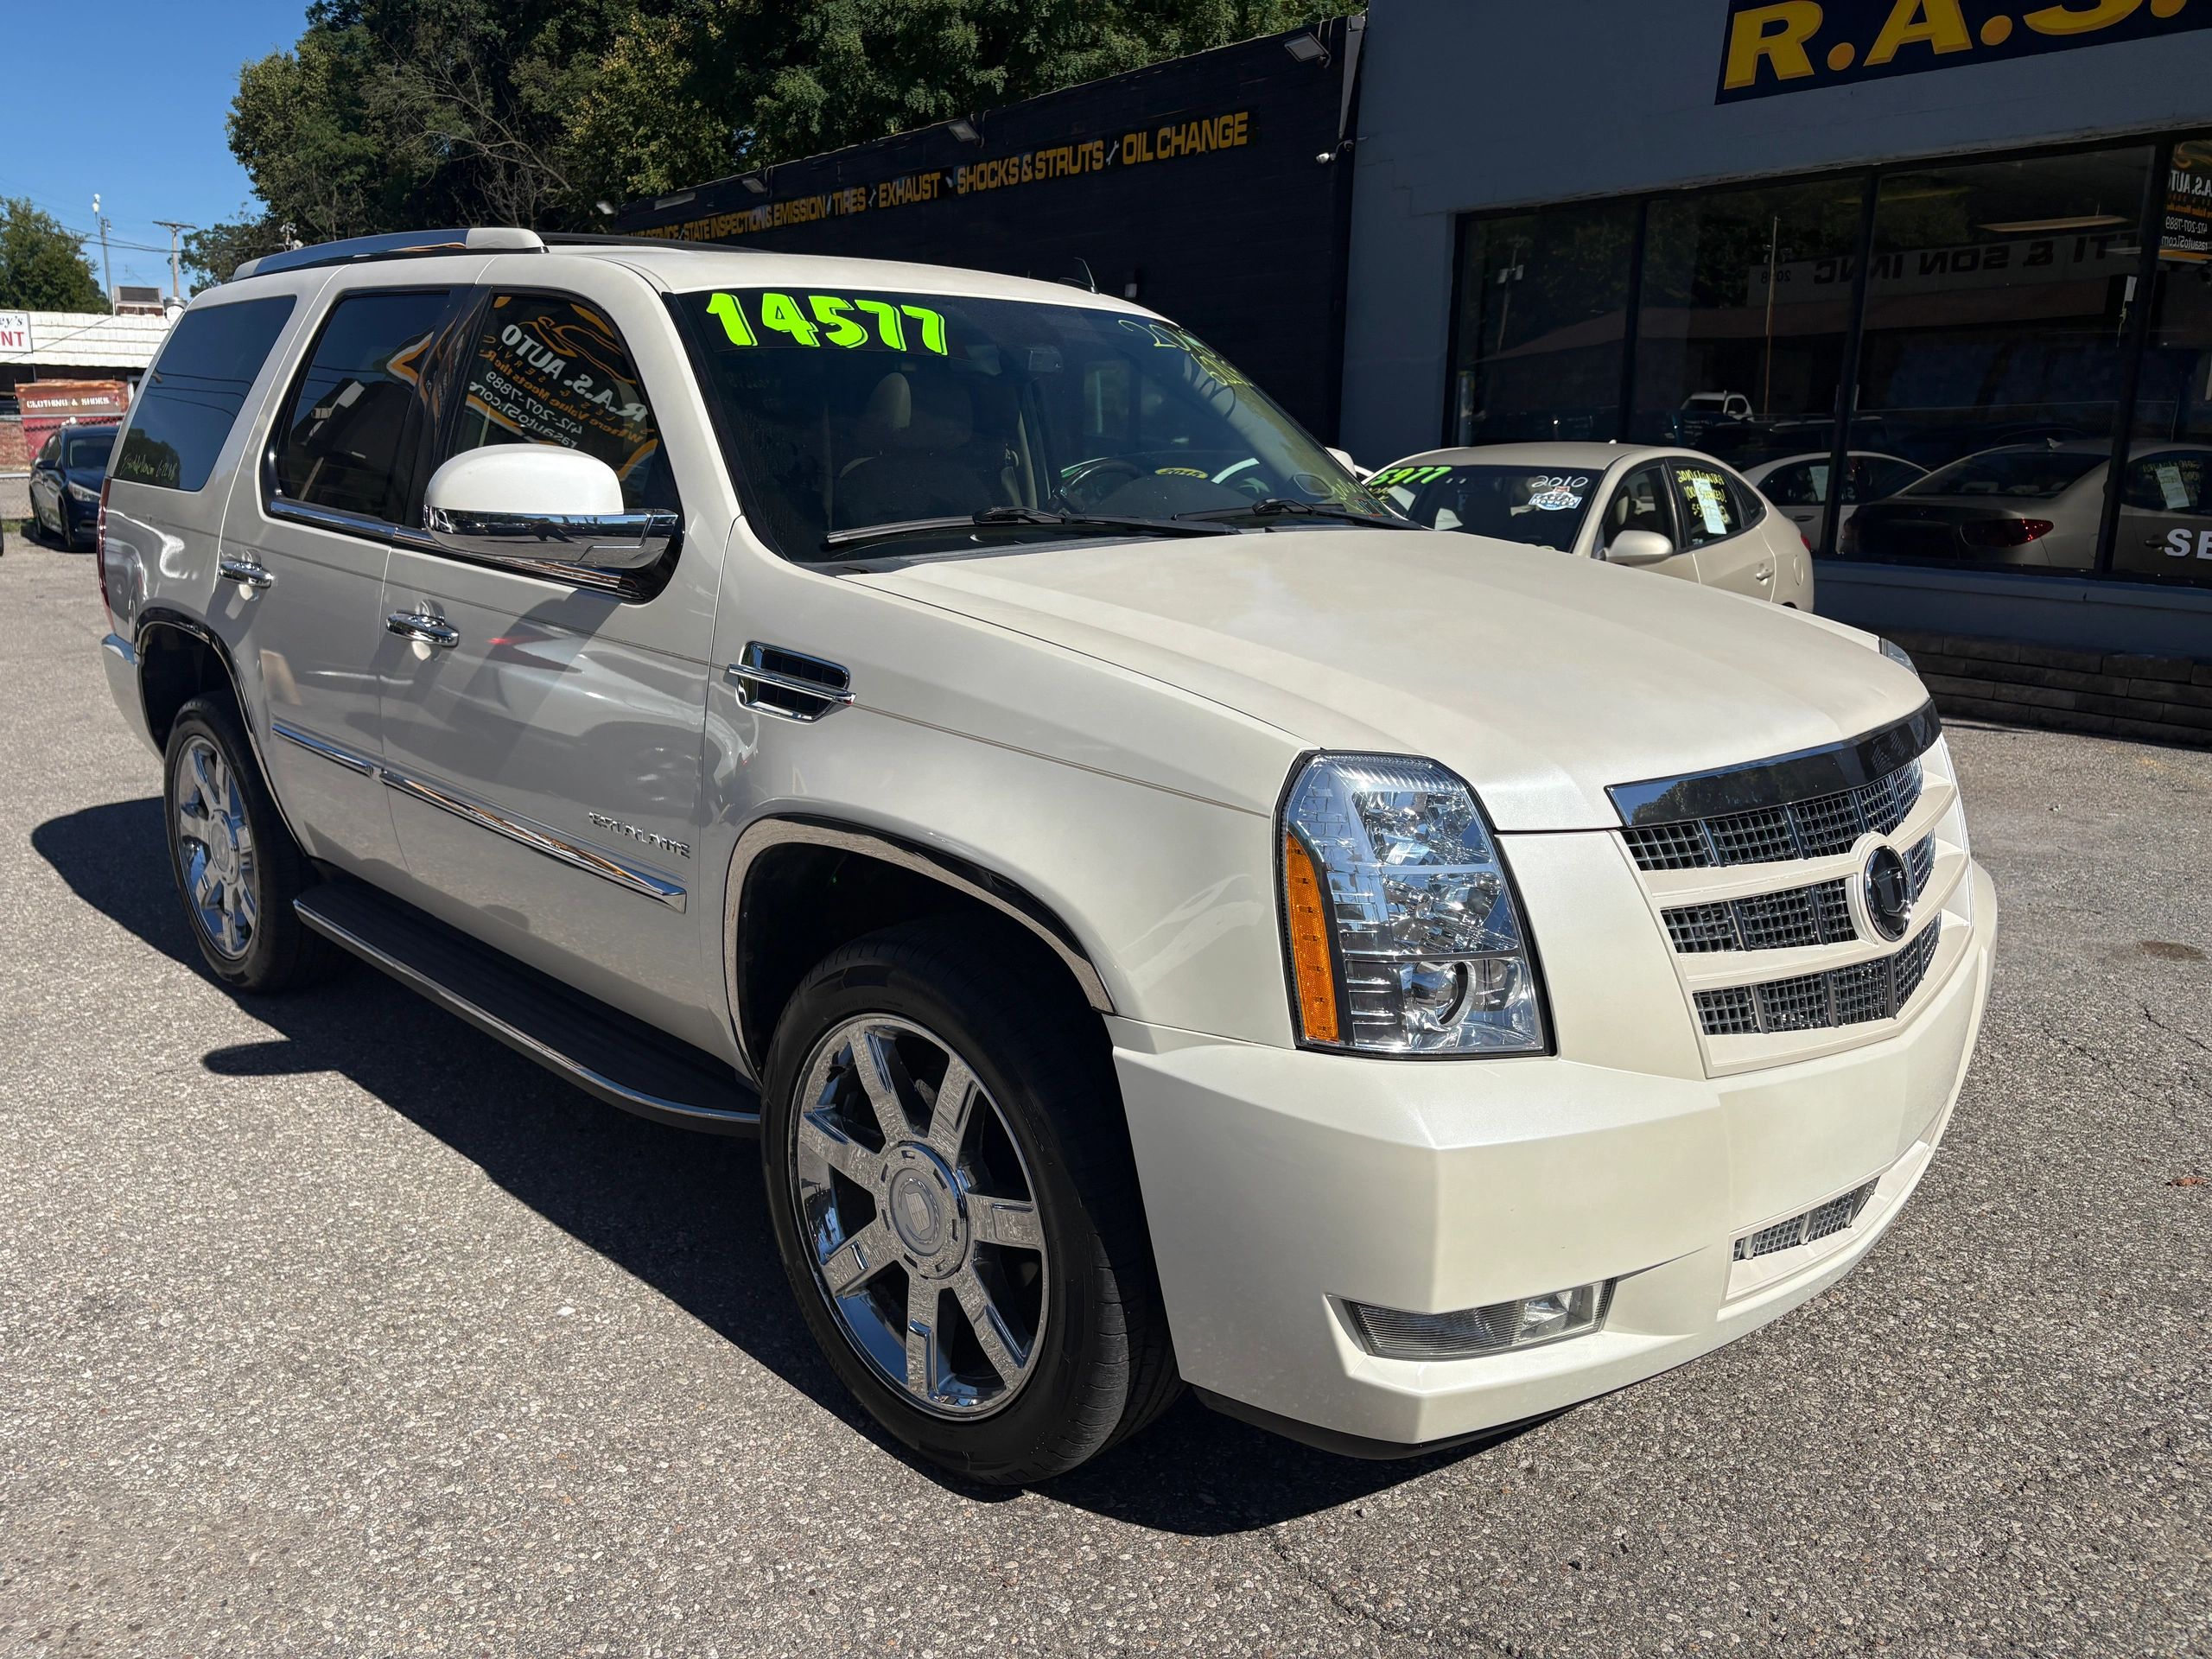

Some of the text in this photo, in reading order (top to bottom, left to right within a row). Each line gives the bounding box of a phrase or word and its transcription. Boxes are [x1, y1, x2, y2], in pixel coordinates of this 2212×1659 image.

[683, 217, 710, 241] STATE
[774, 195, 826, 227] EMISSION
[832, 187, 867, 215] TIRES
[878, 171, 941, 208] EXHAUST
[957, 156, 1020, 195] SHOCKS
[1021, 154, 1034, 183] &
[1035, 139, 1104, 181] STRUTS
[1122, 131, 1154, 166] OIL
[1156, 111, 1249, 159] CHANGE
[1, 331, 24, 347] NT
[706, 293, 948, 356] 14577
[1531, 475, 1588, 487] 2010
